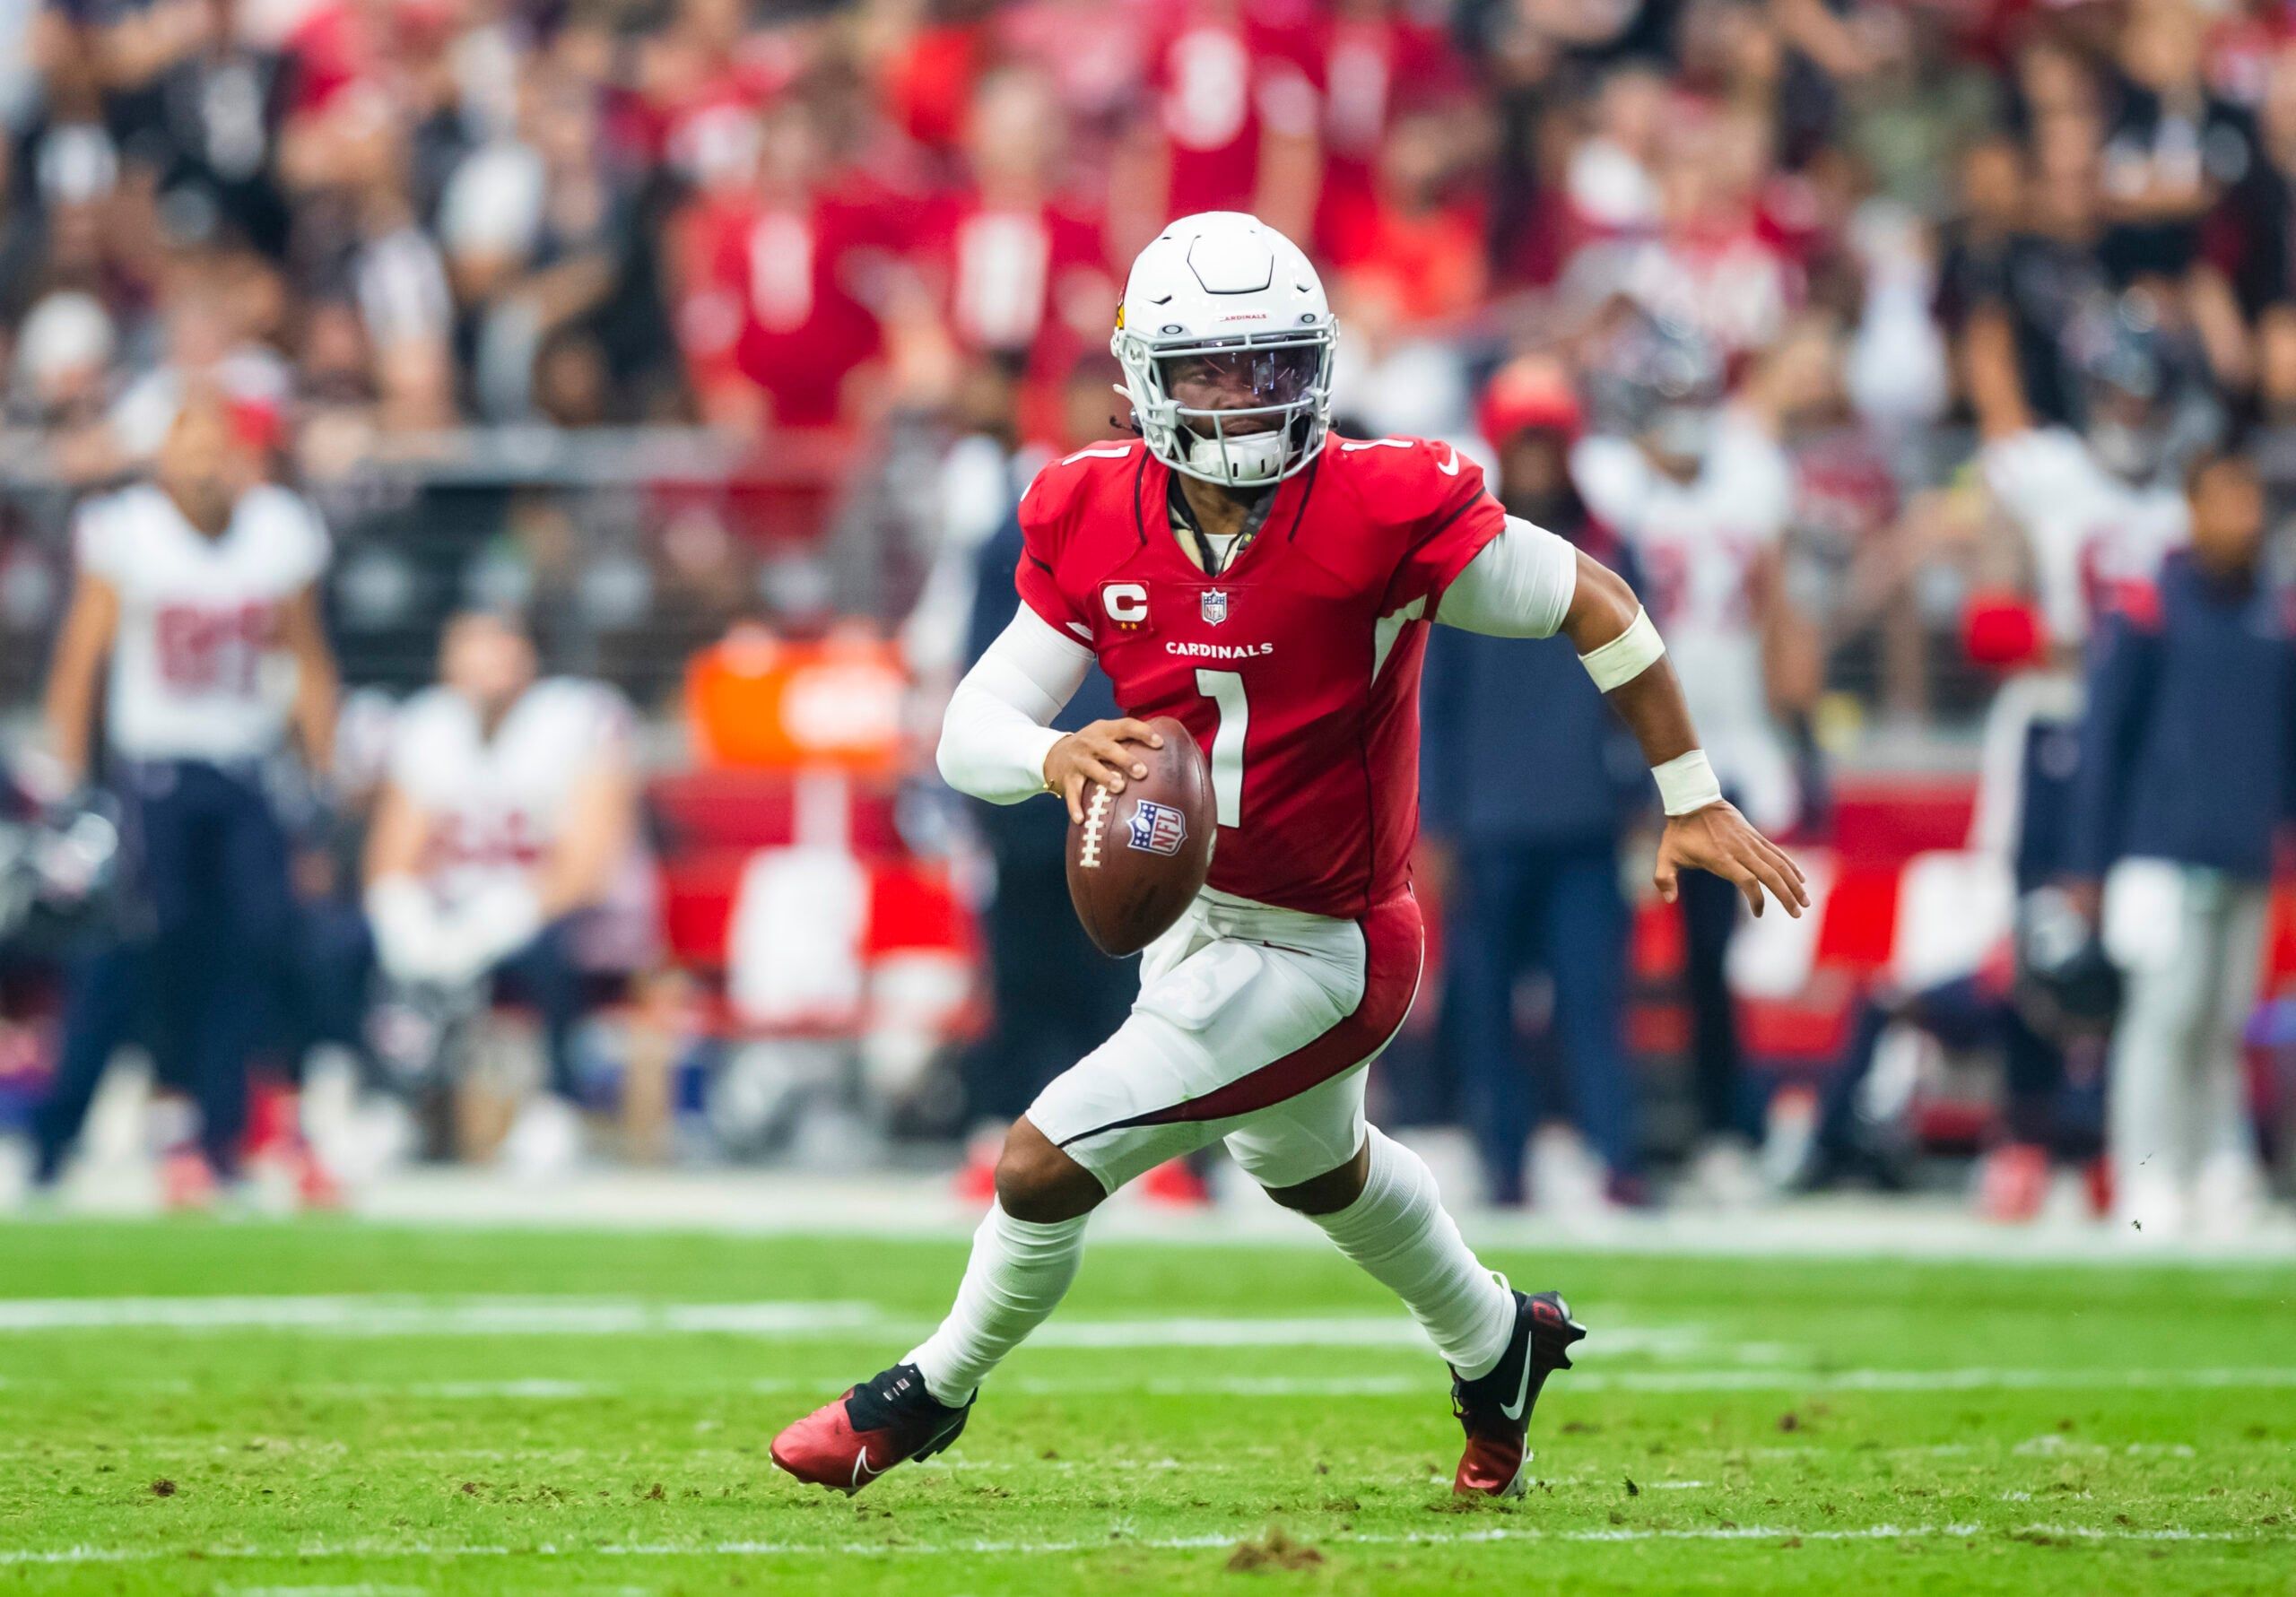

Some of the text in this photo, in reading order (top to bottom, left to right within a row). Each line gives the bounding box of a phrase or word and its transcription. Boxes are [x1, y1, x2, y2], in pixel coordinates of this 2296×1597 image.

[1102, 584, 1147, 622] C
[1166, 641, 1273, 658] CARDINALS
[1196, 669, 1248, 828] 1
[1152, 813, 1179, 850] NFL
